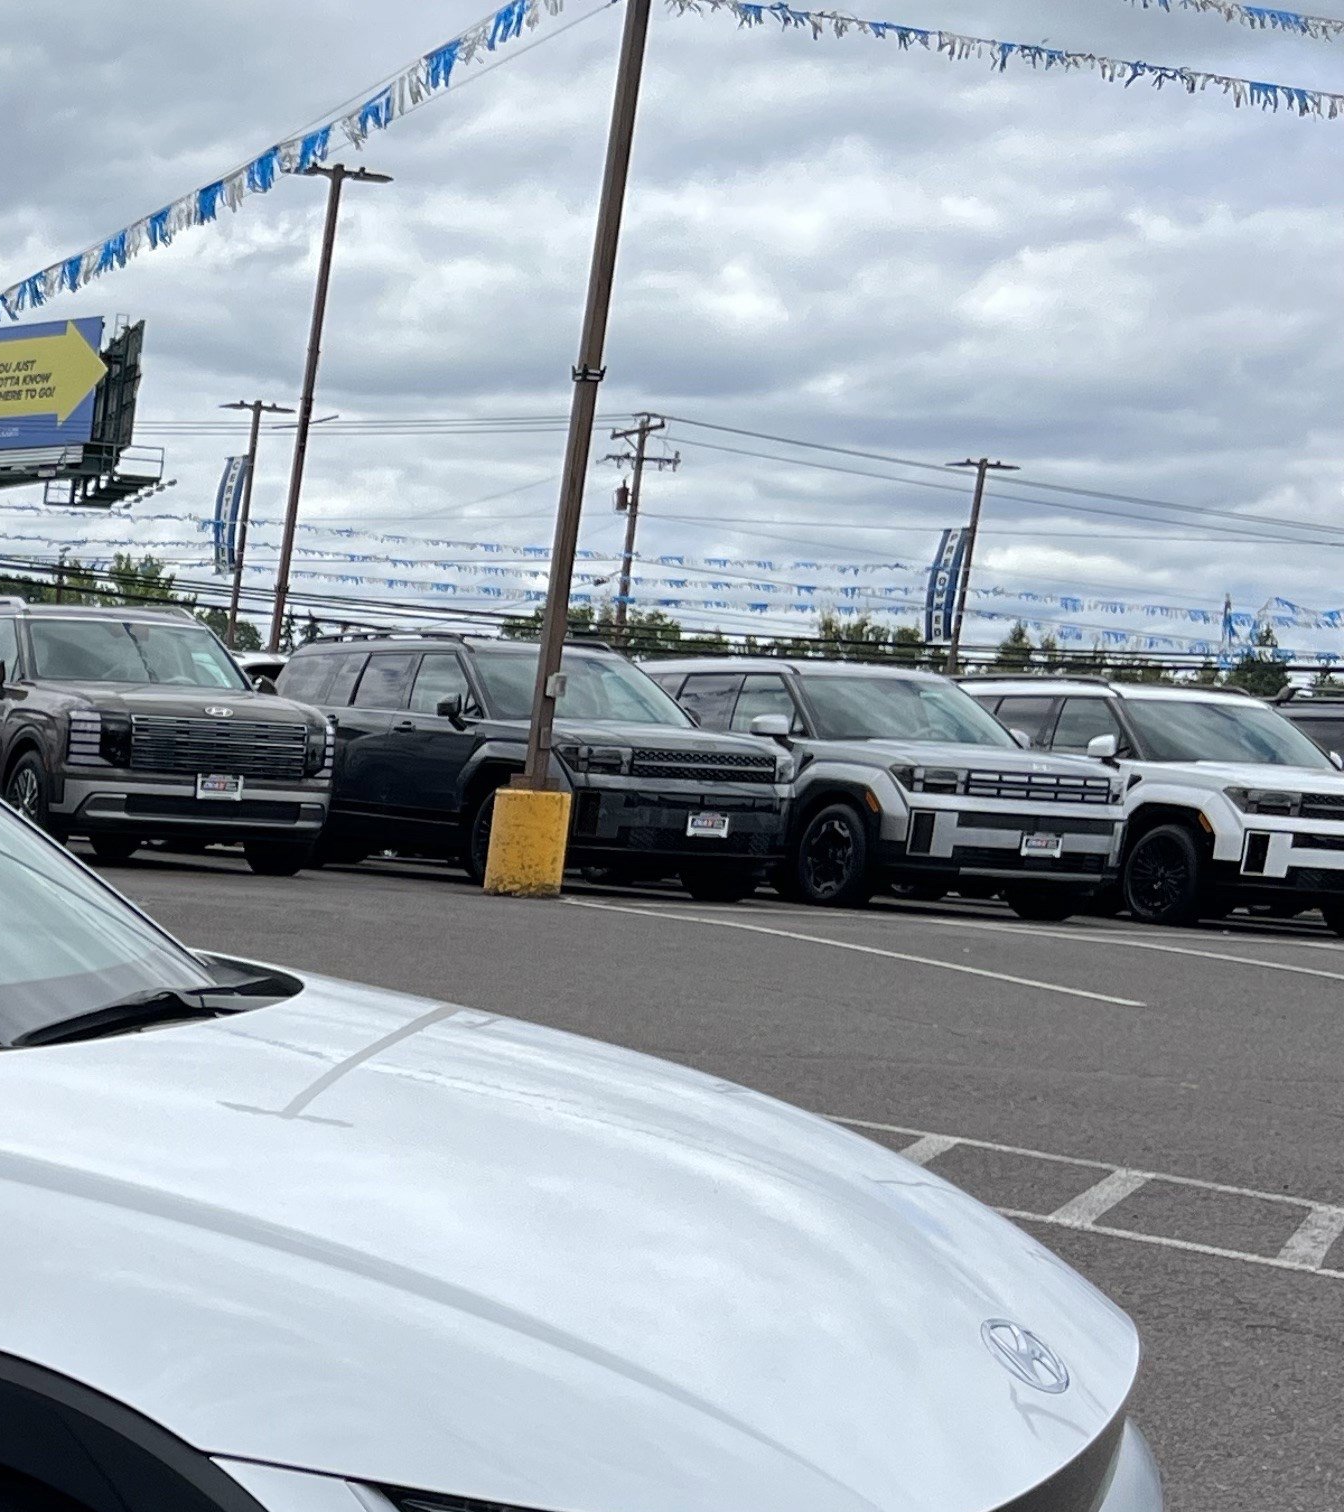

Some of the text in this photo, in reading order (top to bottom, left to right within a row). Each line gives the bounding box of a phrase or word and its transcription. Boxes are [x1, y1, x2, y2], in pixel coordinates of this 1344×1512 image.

[13, 360, 37, 372] JUST
[22, 372, 53, 386] KNOW
[25, 387, 37, 400] TO
[38, 386, 56, 399] GO!
